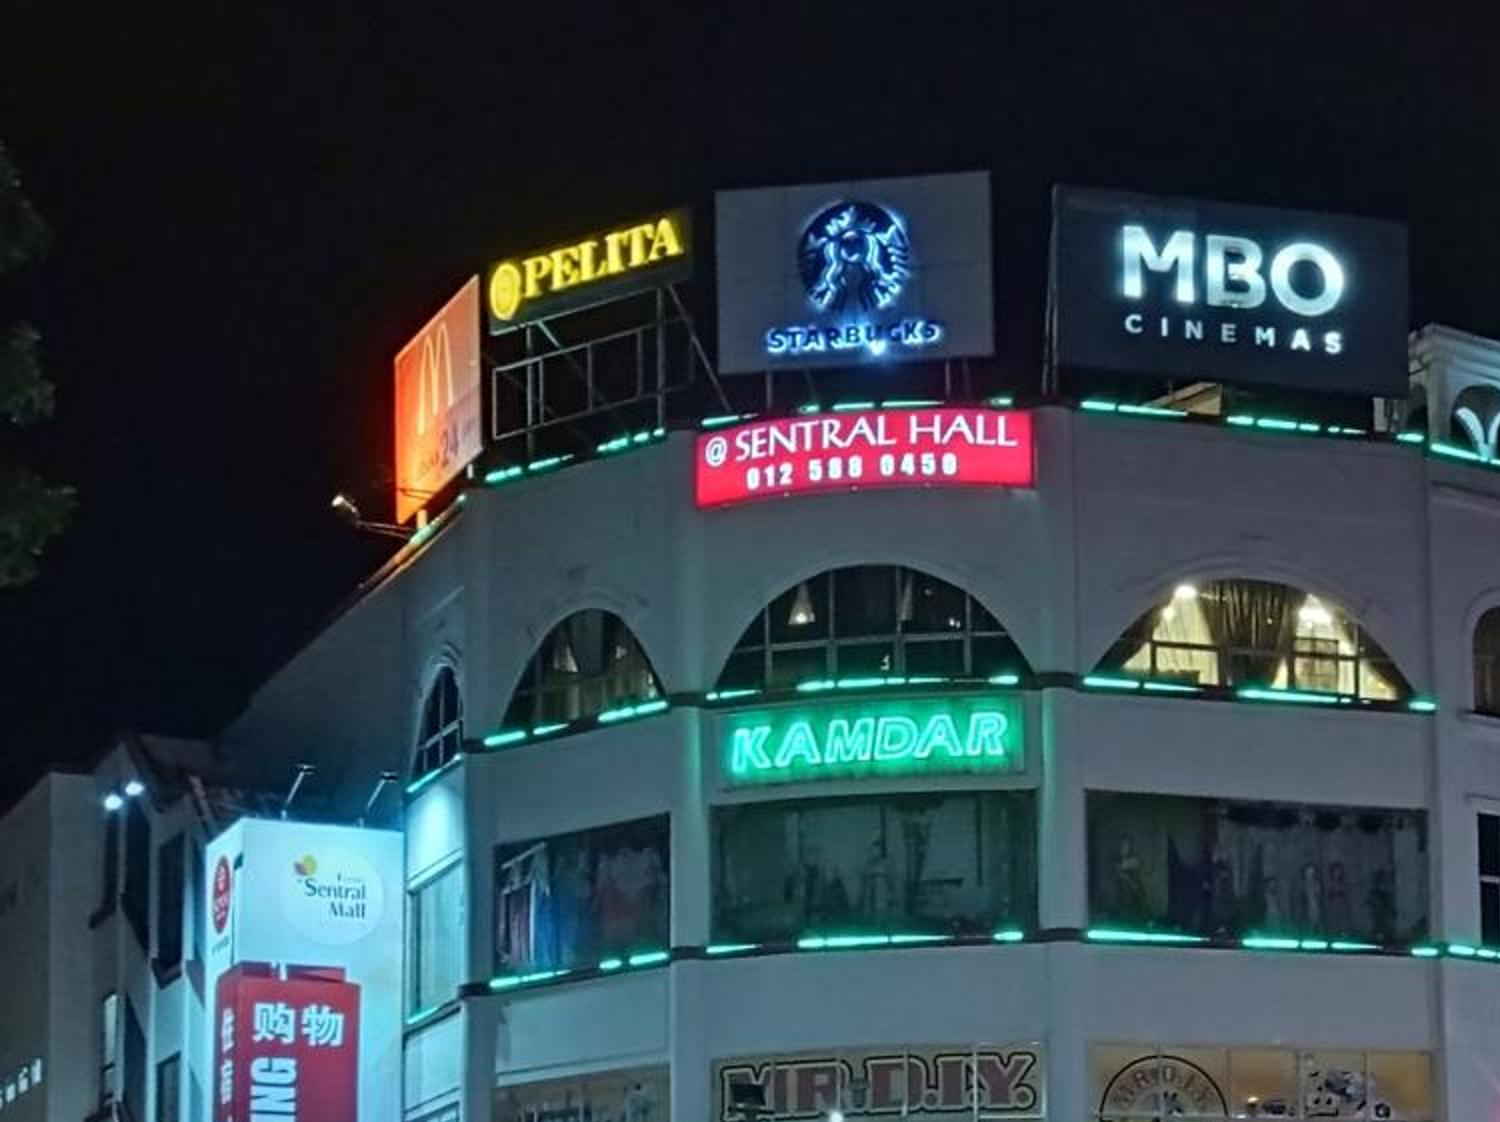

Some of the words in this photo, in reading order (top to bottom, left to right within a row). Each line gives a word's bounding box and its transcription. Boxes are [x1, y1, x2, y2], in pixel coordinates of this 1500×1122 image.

[522, 218, 684, 299] PELITA
[1122, 225, 1345, 317] MBO
[767, 318, 943, 354] STARBUCKS
[1124, 313, 1343, 355] CINEMAS
[705, 436, 728, 466] @
[735, 414, 897, 461] SENTRAL
[909, 414, 1018, 447] HALL
[746, 462, 793, 490] 012
[731, 712, 1009, 773] KAMDAR
[304, 877, 366, 900] Sentral
[329, 901, 366, 918] Mall
[253, 1002, 345, 1047] 购物
